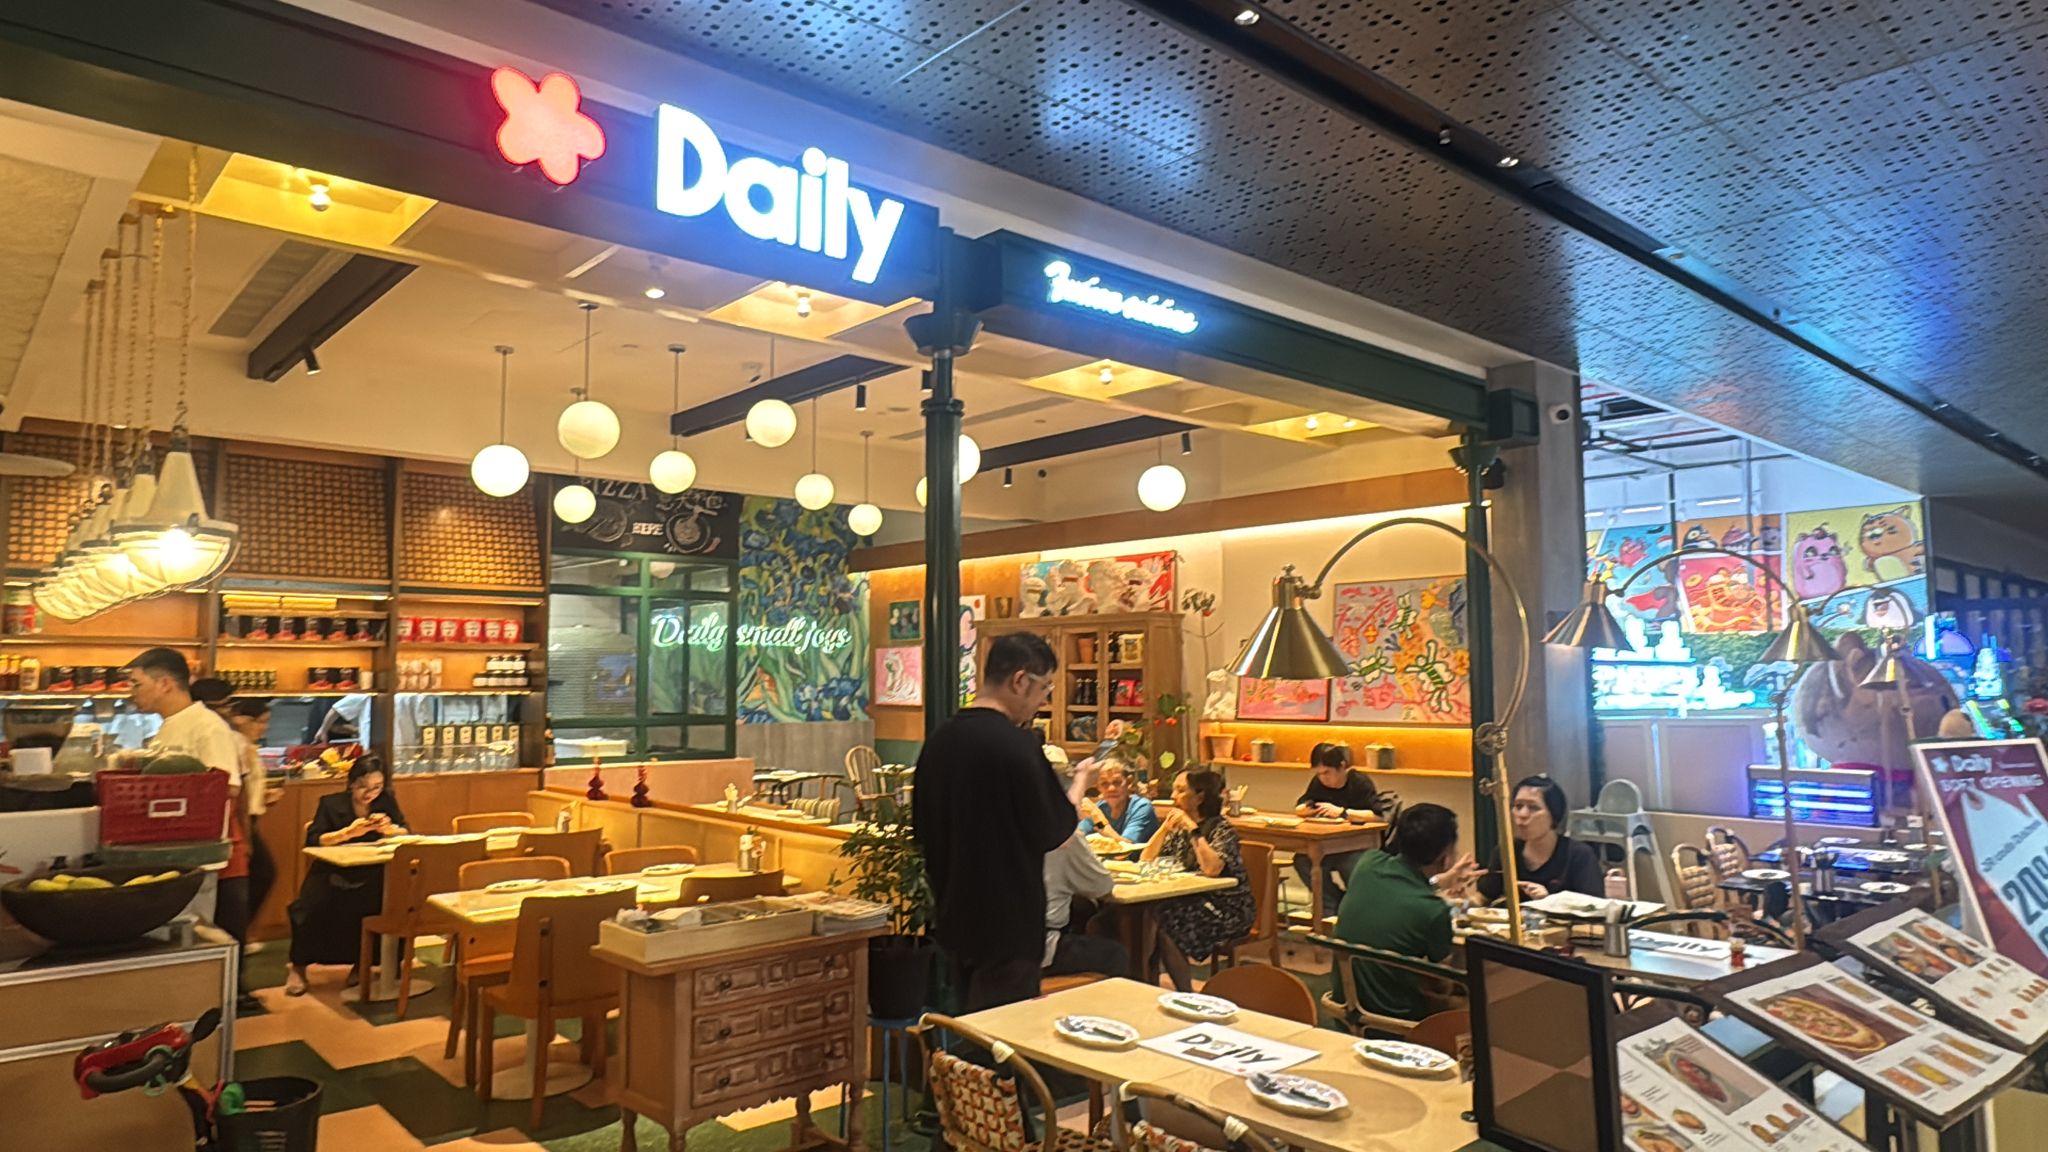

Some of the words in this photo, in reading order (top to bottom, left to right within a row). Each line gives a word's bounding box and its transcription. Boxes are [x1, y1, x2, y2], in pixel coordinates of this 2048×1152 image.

[656, 102, 905, 284] Daily
[651, 611, 728, 653] Daily
[736, 616, 803, 648] small
[794, 620, 852, 655] joys
[1950, 754, 1993, 774] Daily
